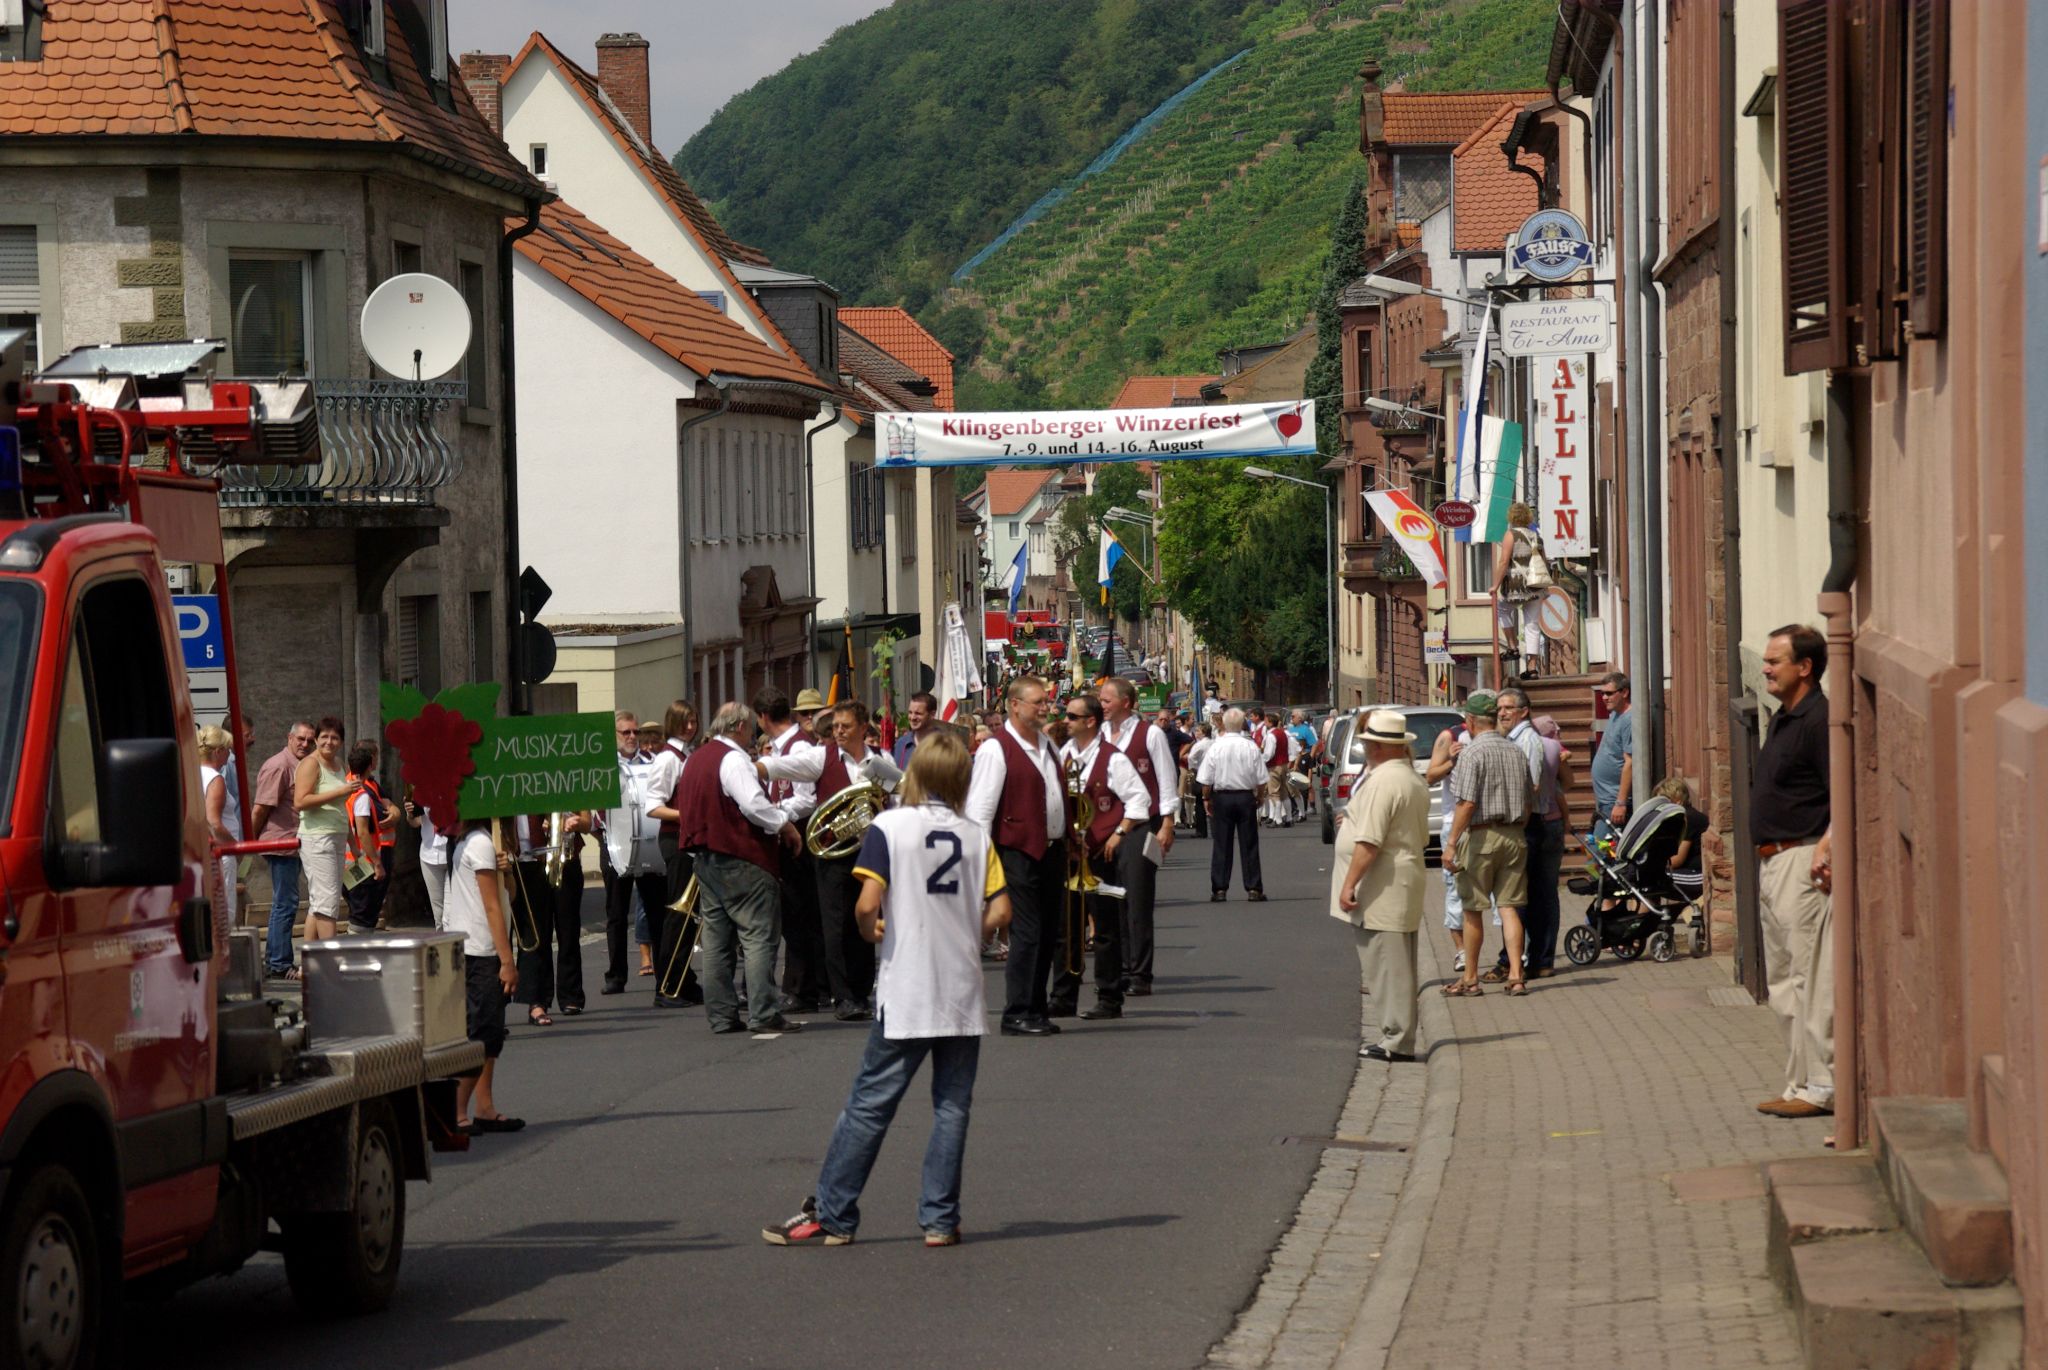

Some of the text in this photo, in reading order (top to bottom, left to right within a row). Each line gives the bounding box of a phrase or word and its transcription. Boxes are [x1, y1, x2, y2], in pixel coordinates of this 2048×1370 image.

[1525, 240, 1581, 259] FAUST
[1510, 315, 1600, 328] RESTAURANT
[1541, 306, 1568, 315] BAR
[942, 412, 1243, 441] Klingenberger Winzerfest
[1003, 438, 1205, 456] 7.-9. und 14.-16. August
[1552, 358, 1579, 540] ALL IN
[206, 645, 214, 659] 5
[494, 732, 603, 761] MUSIKZUG
[474, 767, 616, 799] TV TRENNFURT
[925, 830, 962, 895] 2
